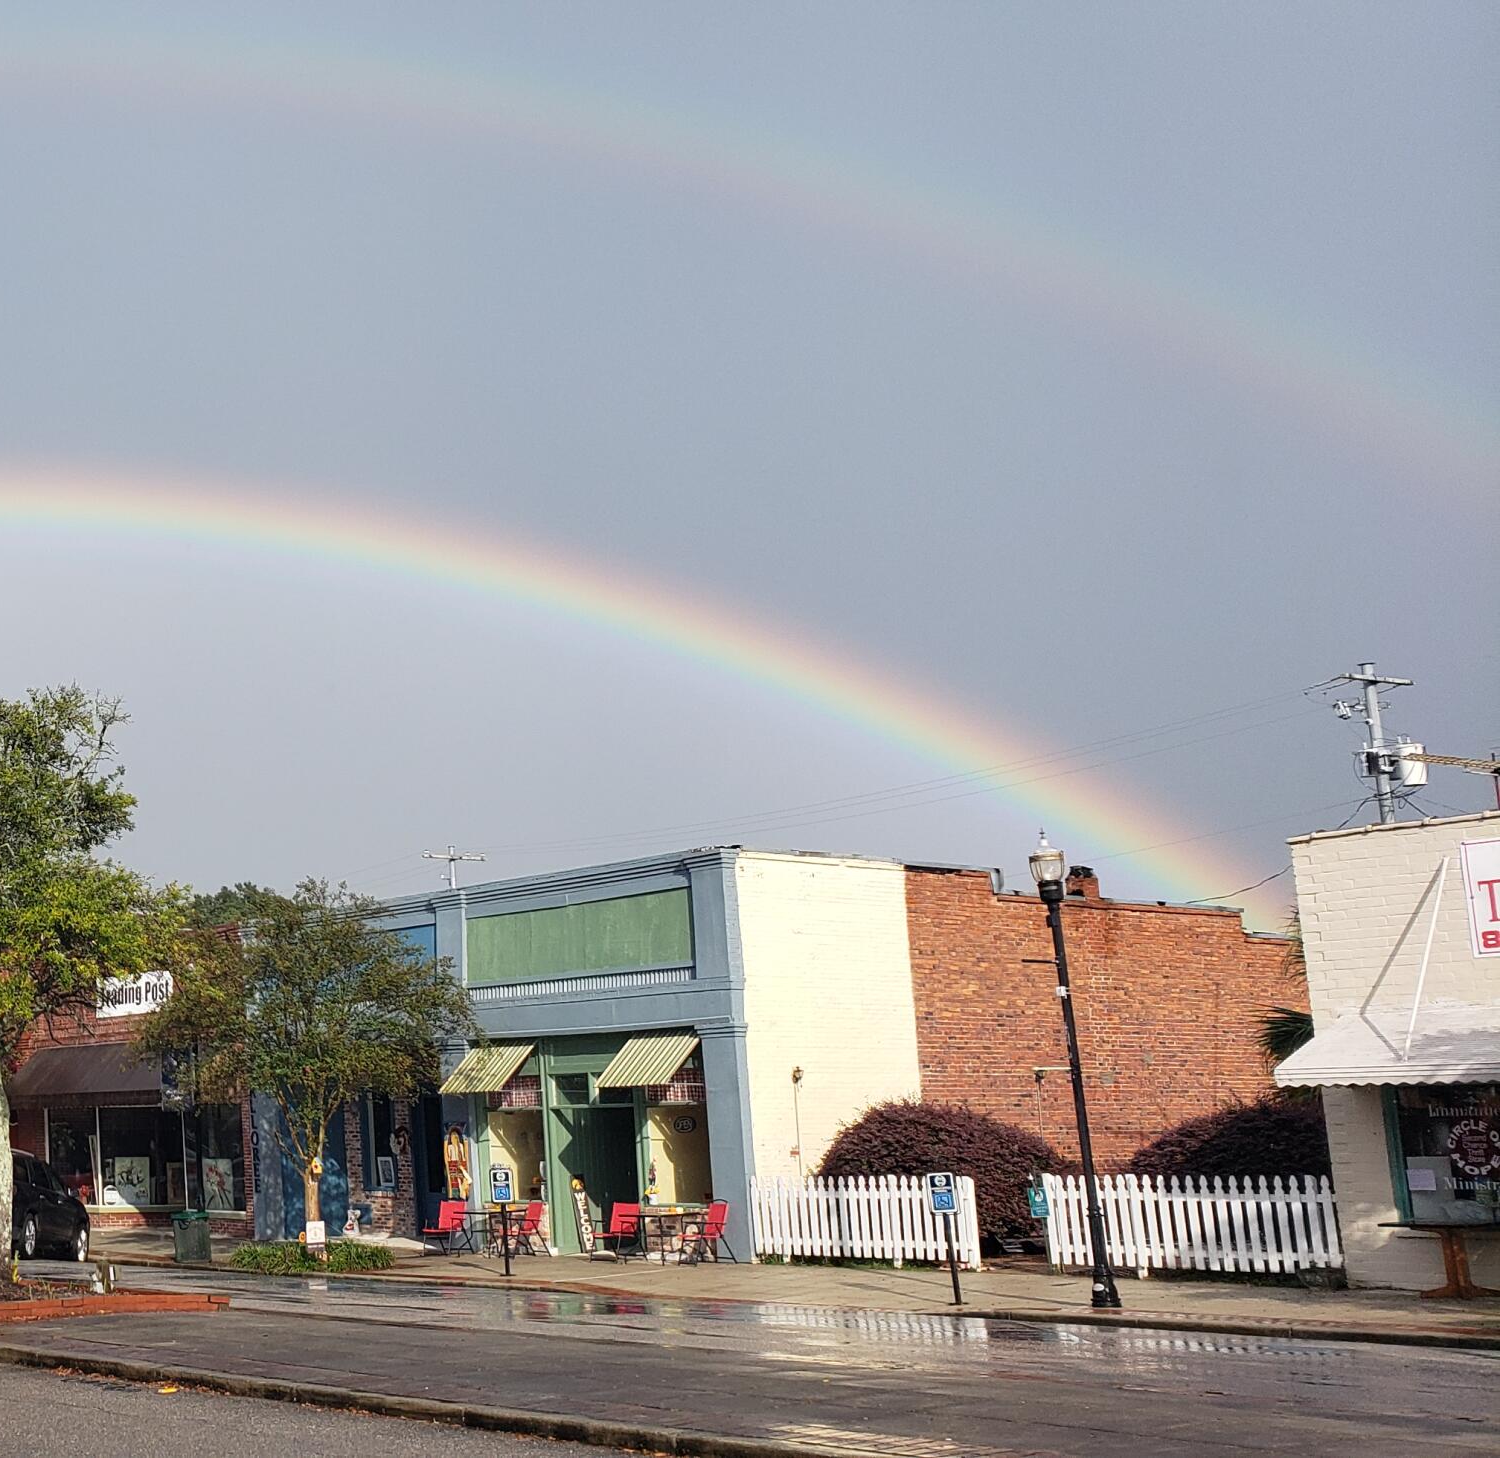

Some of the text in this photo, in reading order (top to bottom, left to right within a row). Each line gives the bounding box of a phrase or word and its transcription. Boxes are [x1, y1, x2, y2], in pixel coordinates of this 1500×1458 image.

[100, 979, 169, 1006] rading Post
[1447, 1119, 1488, 1149] CIRCLE
[574, 1191, 595, 1250] WELCOME
